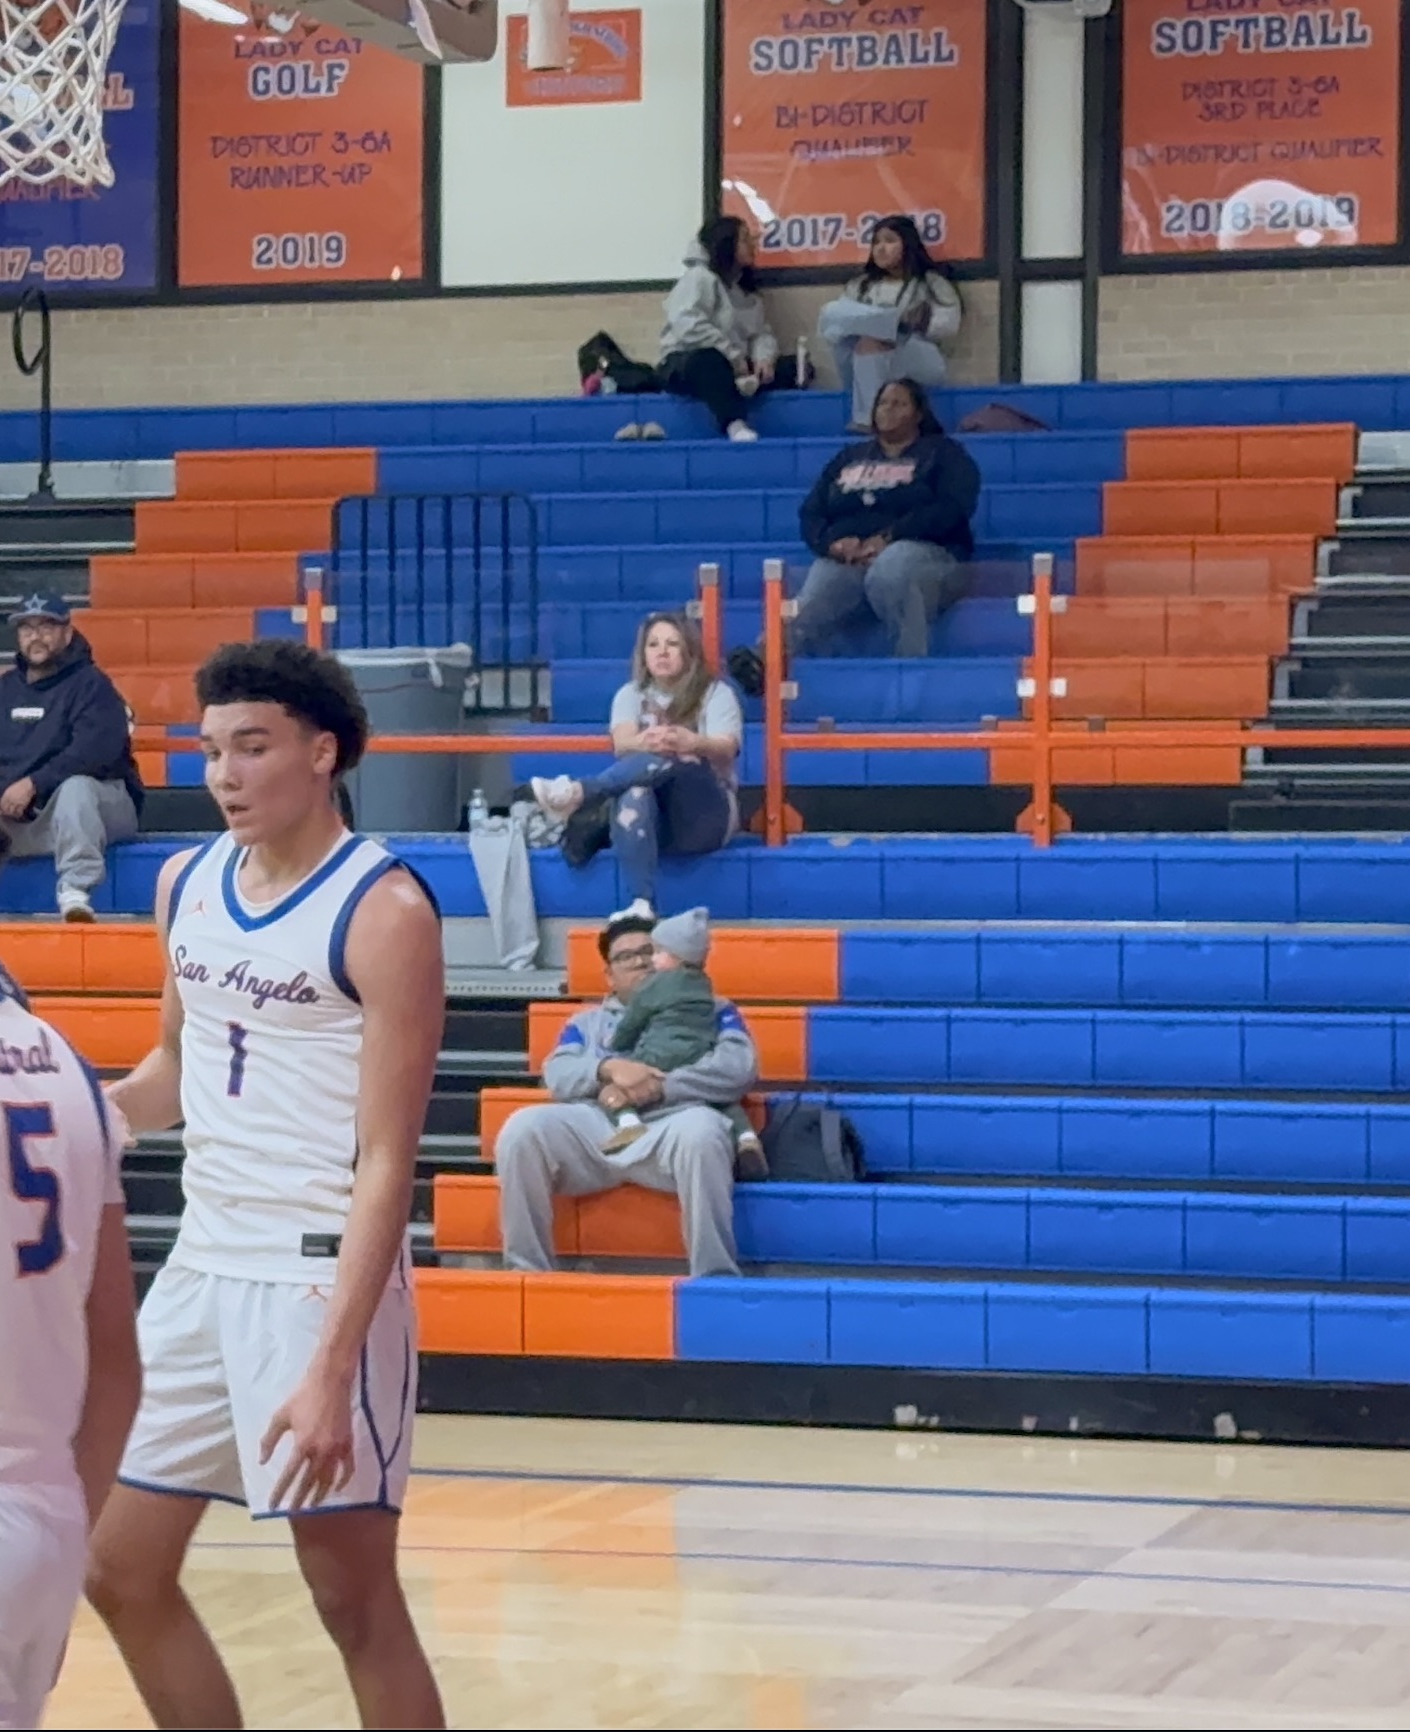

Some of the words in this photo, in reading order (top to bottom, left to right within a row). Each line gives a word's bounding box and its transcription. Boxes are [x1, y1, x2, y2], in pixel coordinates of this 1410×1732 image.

[782, 9, 856, 31] LADY
[867, 5, 925, 26] CAT
[1151, 8, 1372, 59] SOFTBALL
[233, 39, 303, 59] LADY
[315, 37, 362, 56] CAT
[750, 27, 959, 76] SOFTBALL
[249, 58, 349, 101] GOLF
[1182, 78, 1276, 101] DISTRICT
[775, 98, 930, 129] BI-DISTRICT
[1197, 103, 1246, 122] 3RD
[1256, 100, 1323, 121] PLACE
[210, 132, 322, 159] DISTRICT
[1270, 136, 1384, 162] QUALIFIER
[230, 162, 374, 190] RUNNER-UP
[1162, 192, 1359, 238] 2018-2019
[252, 231, 347, 270] 2019
[174, 944, 211, 984] San
[217, 959, 321, 1010] Angelo
[225, 1020, 249, 1099] 1
[0, 1101, 65, 1279] 5
